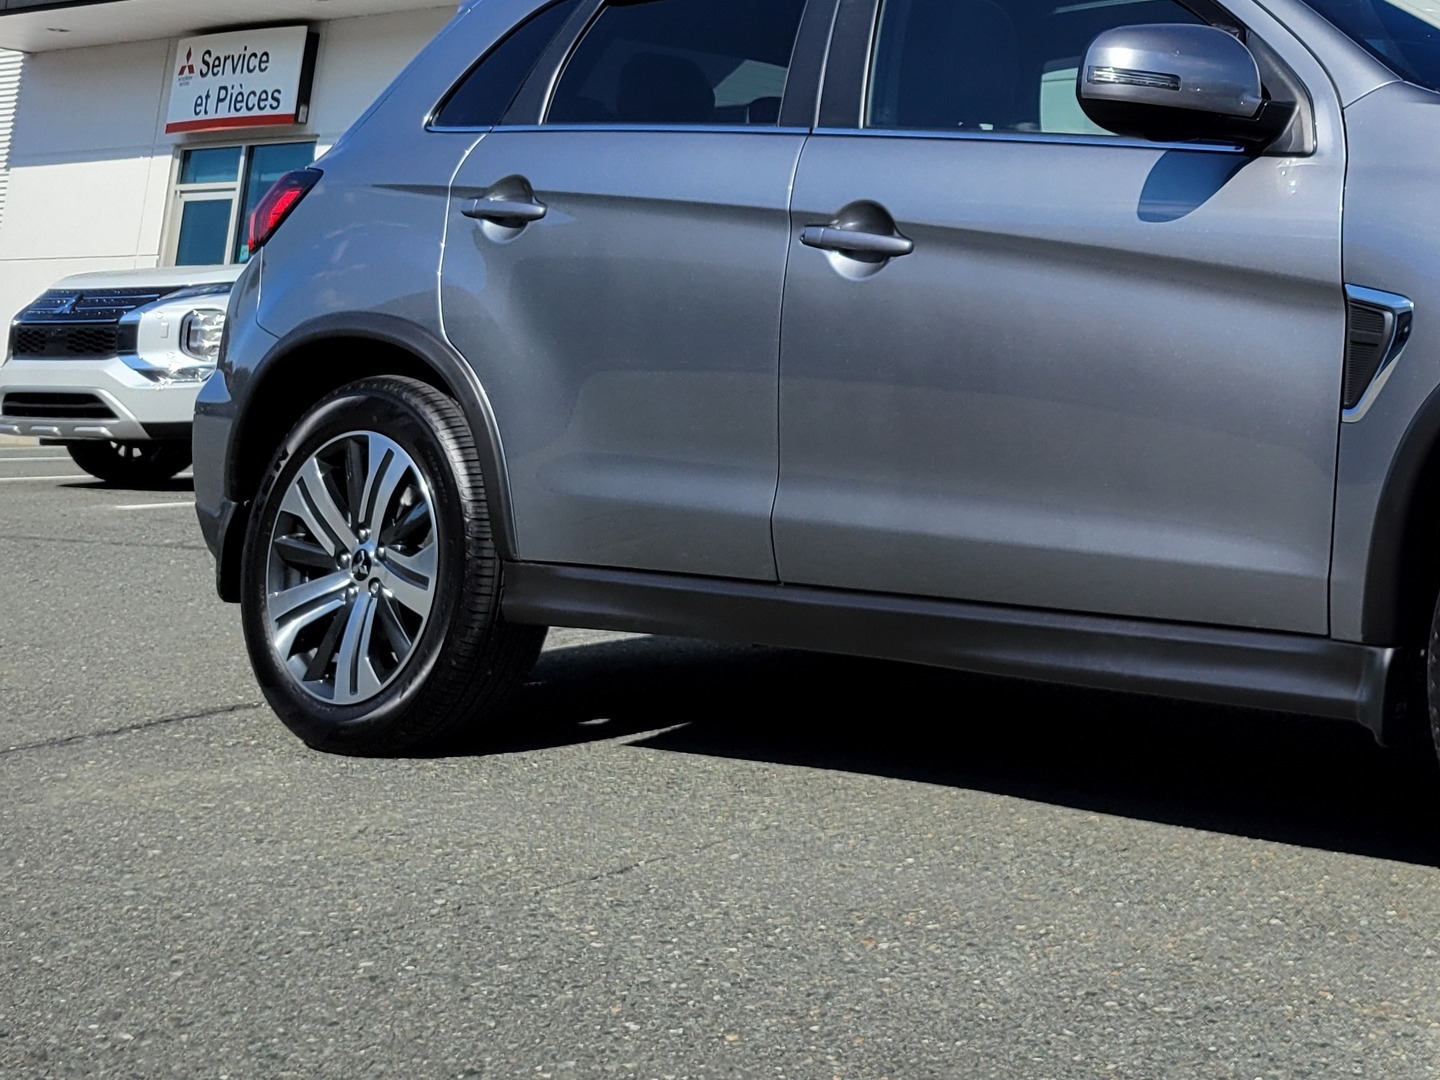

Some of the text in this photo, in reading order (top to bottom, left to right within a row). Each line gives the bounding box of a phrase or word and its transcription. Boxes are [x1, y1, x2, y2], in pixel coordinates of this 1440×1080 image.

[200, 45, 270, 78] Service
[194, 83, 282, 116] et Pièces
